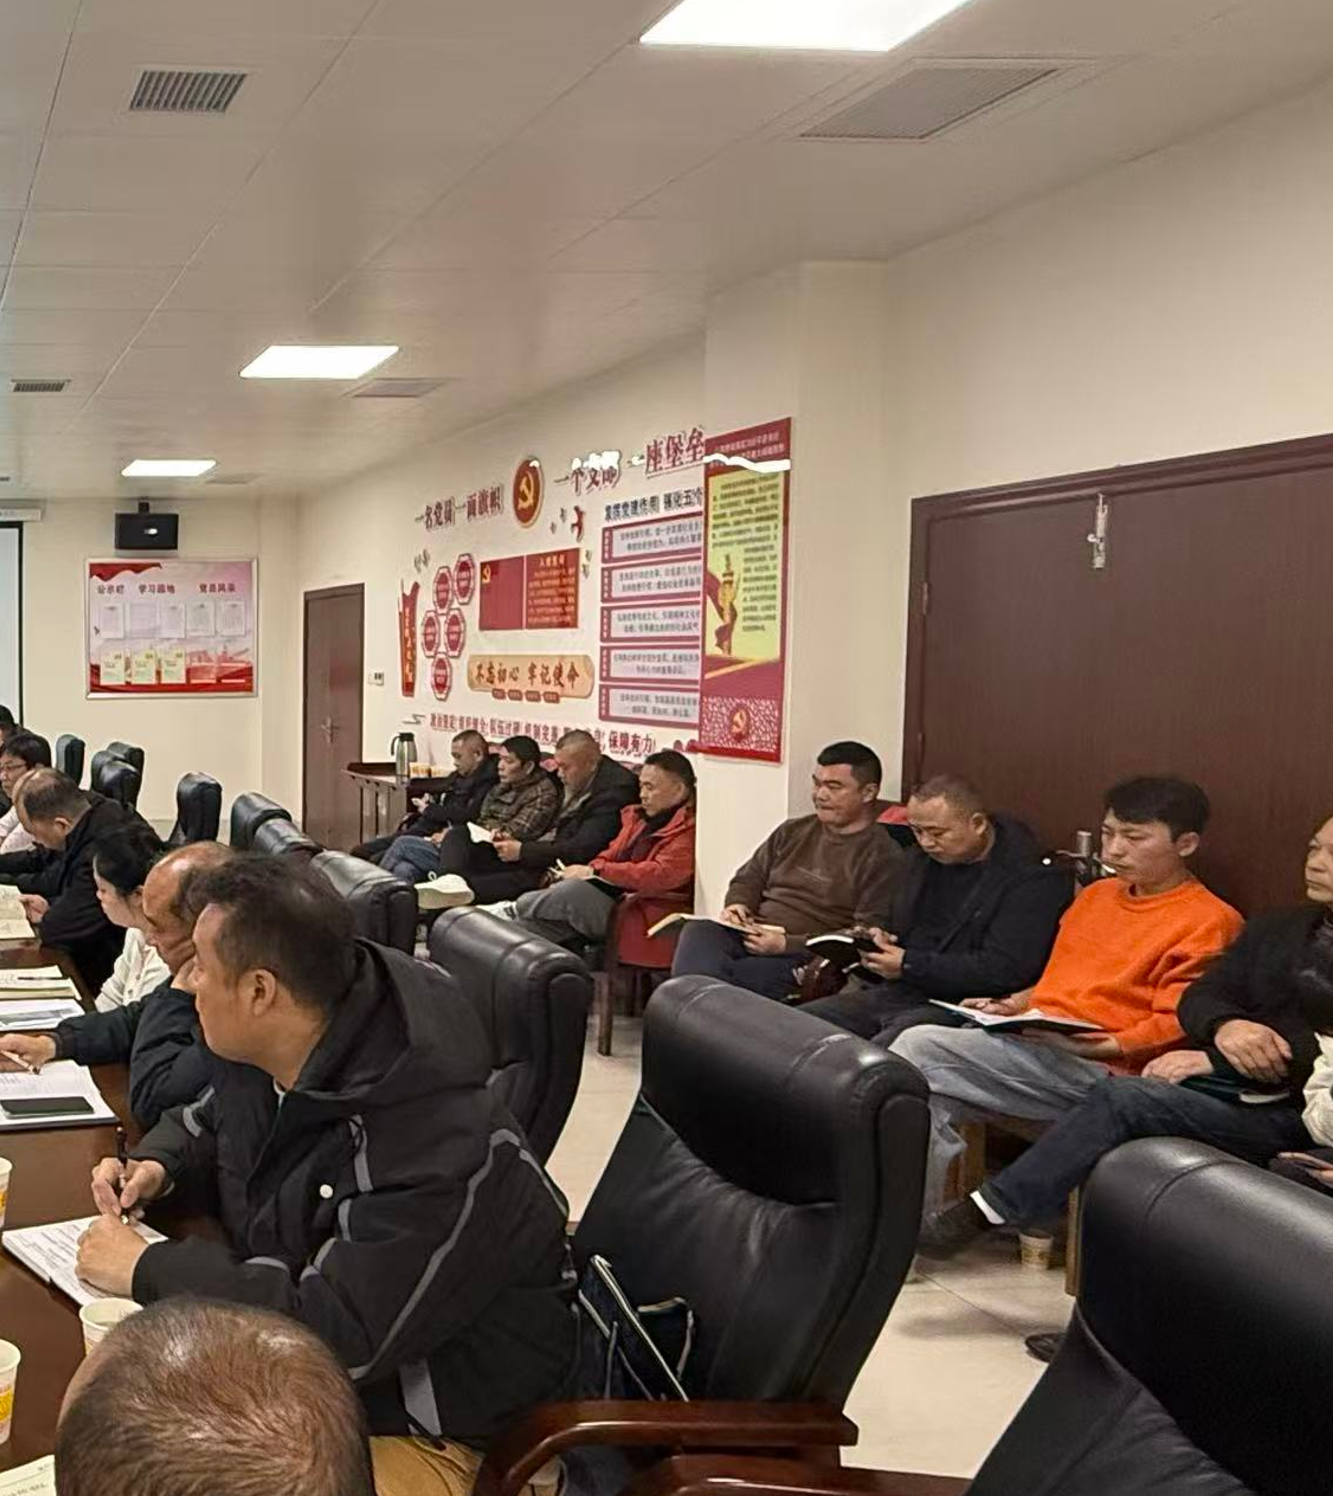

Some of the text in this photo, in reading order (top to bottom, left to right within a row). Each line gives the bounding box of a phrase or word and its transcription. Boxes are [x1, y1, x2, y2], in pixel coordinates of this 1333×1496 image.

[475, 661, 519, 685] 不忘初心
[528, 661, 580, 689] 牢记使命
